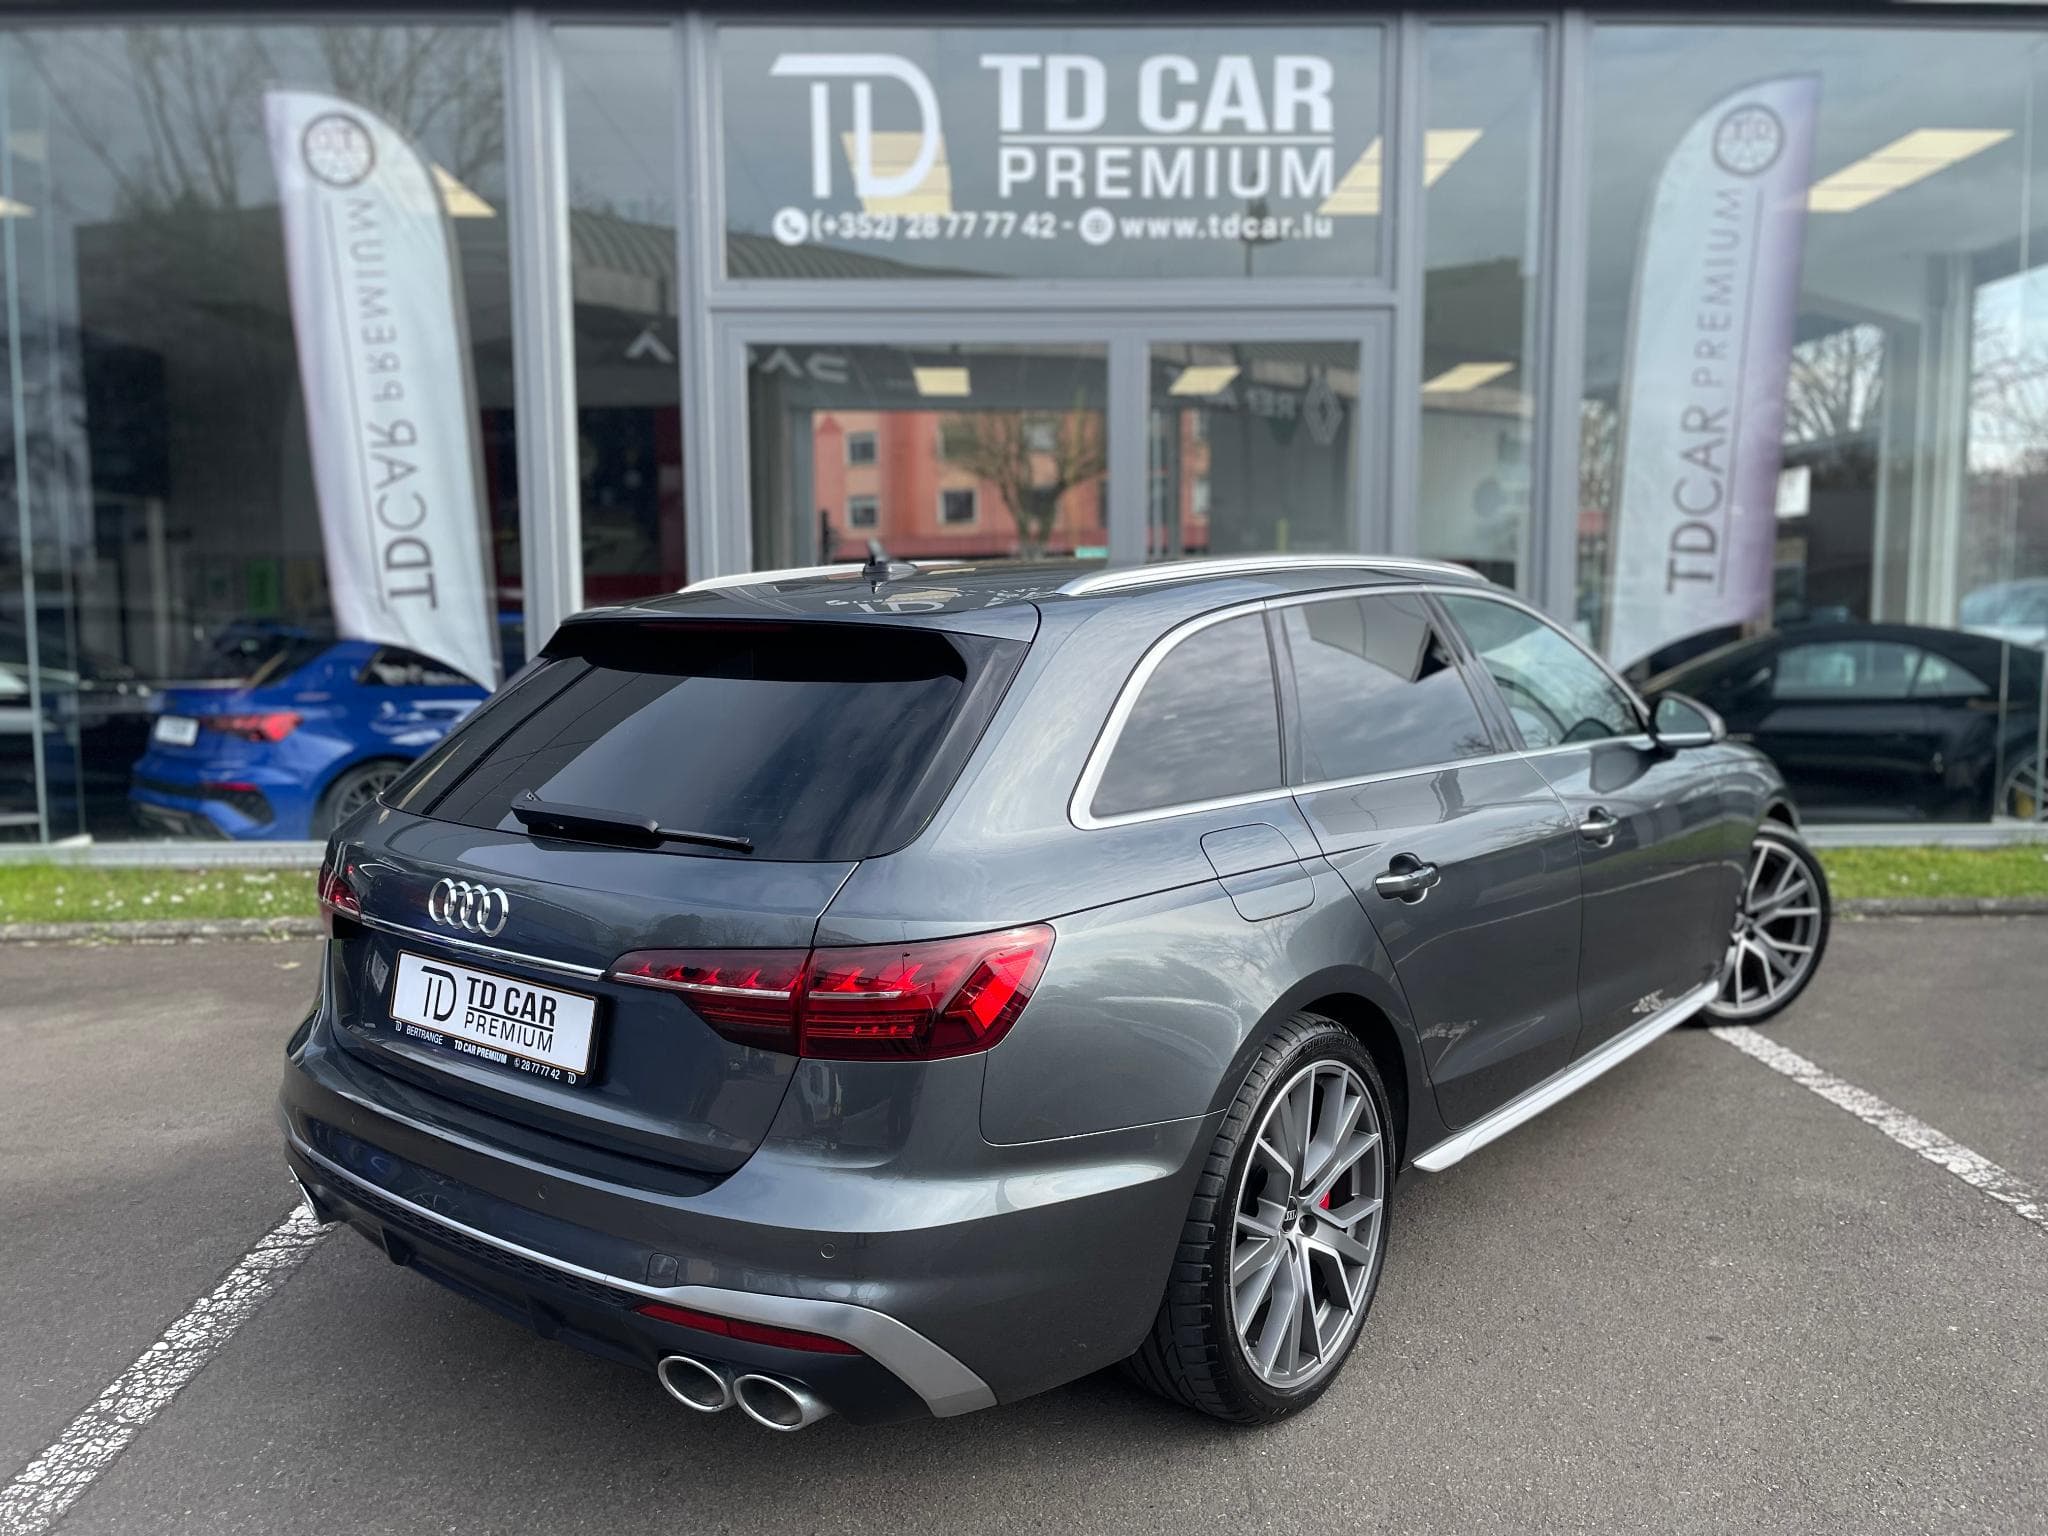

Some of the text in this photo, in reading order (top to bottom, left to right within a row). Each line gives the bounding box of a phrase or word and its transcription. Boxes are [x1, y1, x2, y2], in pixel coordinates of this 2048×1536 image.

[980, 54, 1335, 133] TD CAR
[1001, 147, 1335, 199] PREMIUM
[811, 209, 898, 241] (+352)
[904, 212, 940, 239] 28
[945, 211, 978, 239] 77
[983, 211, 1017, 239] 77
[1020, 211, 1057, 239] 42
[1119, 211, 1334, 240] www.tdcar.lu
[1689, 187, 1744, 390] PREMIUM
[467, 976, 557, 1027] TD CAR
[406, 1025, 444, 1045] BERTRANGE
[454, 1040, 463, 1051] TD
[463, 1042, 477, 1055] CAR
[476, 1047, 508, 1065] PREMIUM
[521, 1060, 530, 1071] 28
[531, 1062, 541, 1074] 77
[541, 1066, 551, 1077] 77
[550, 1069, 561, 1080] 42
[465, 1011, 553, 1053] PREMIUM
